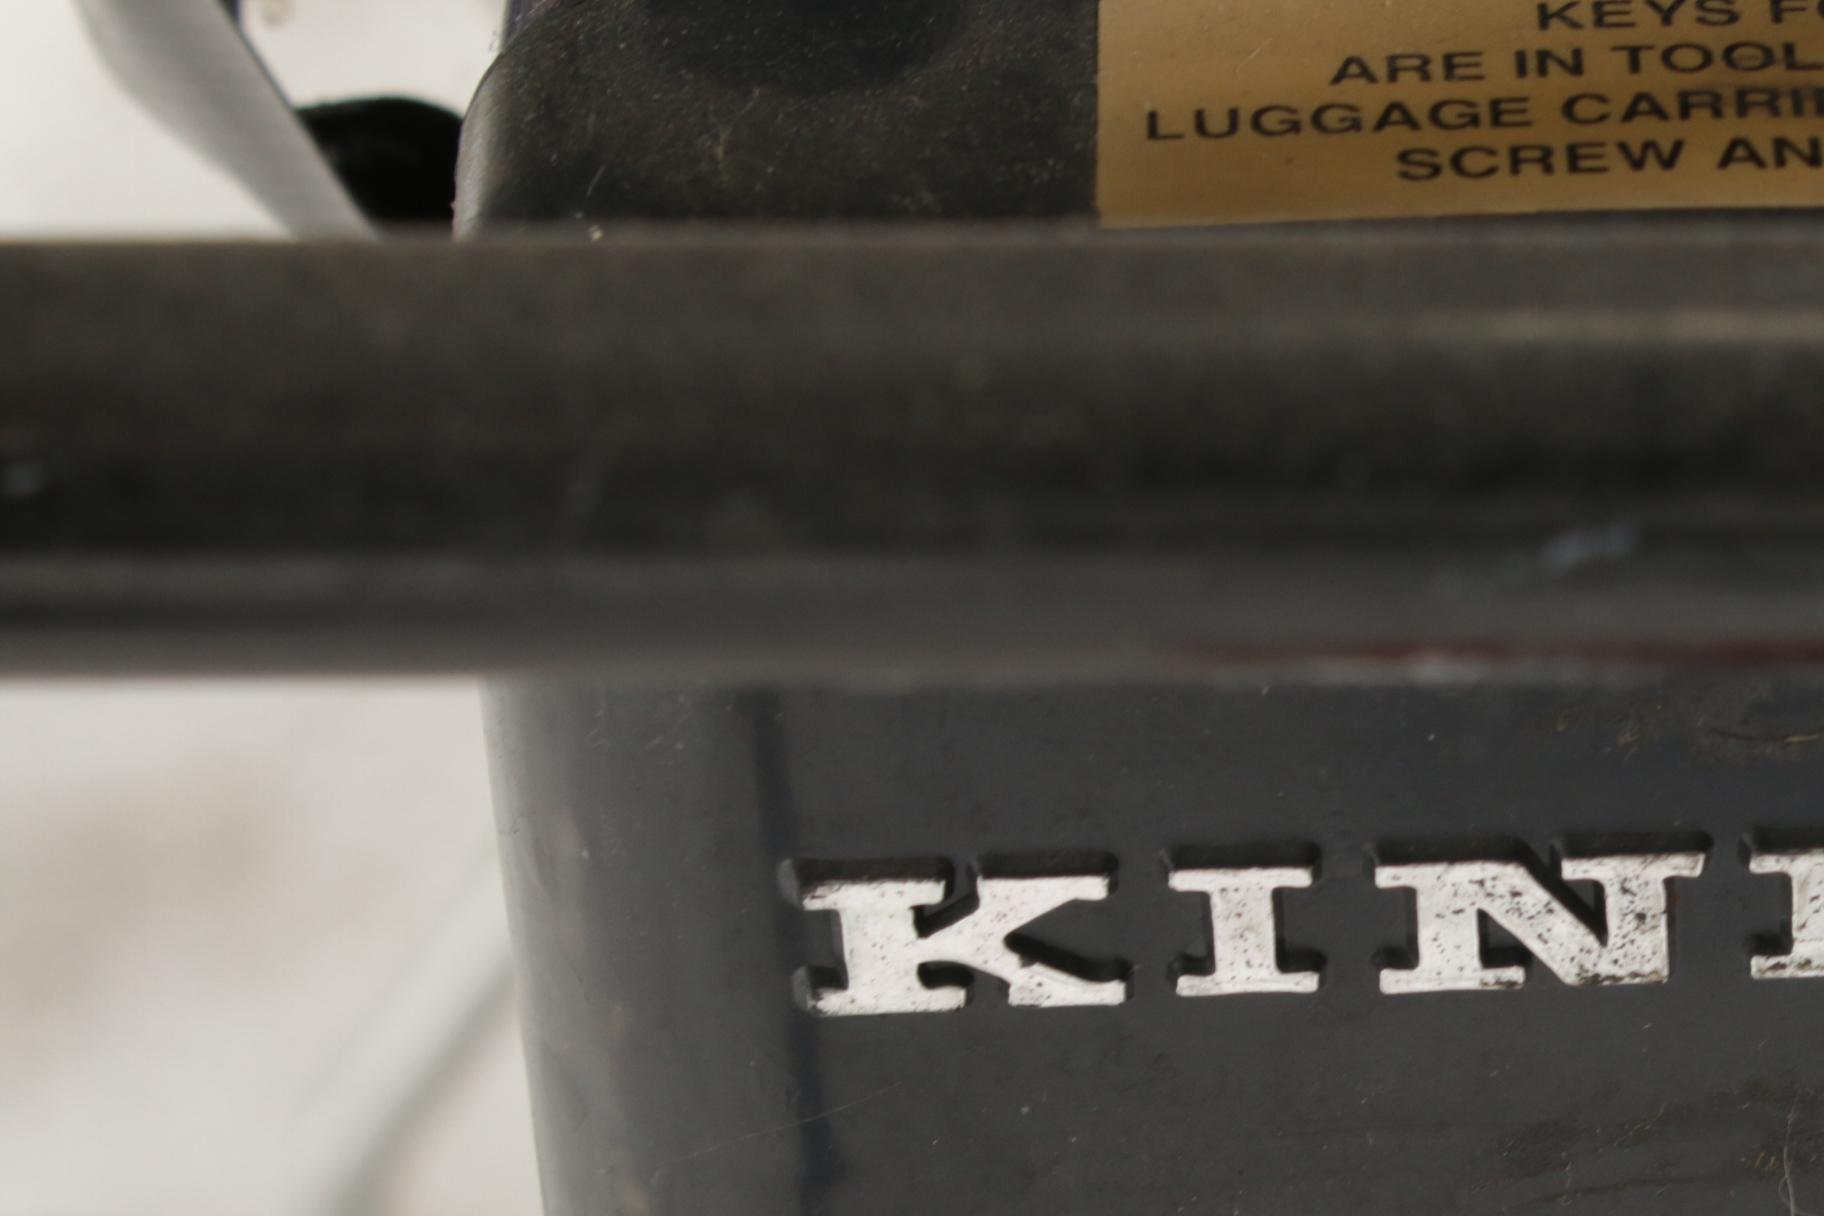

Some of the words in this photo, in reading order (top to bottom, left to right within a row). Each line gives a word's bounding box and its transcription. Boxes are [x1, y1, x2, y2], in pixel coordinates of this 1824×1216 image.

[1329, 50, 1485, 86] ARE
[1514, 47, 1585, 79] IN
[1610, 41, 1824, 75] TOOL
[1145, 97, 1533, 142] LUGGAGE
[1396, 138, 1685, 182] SCREW
